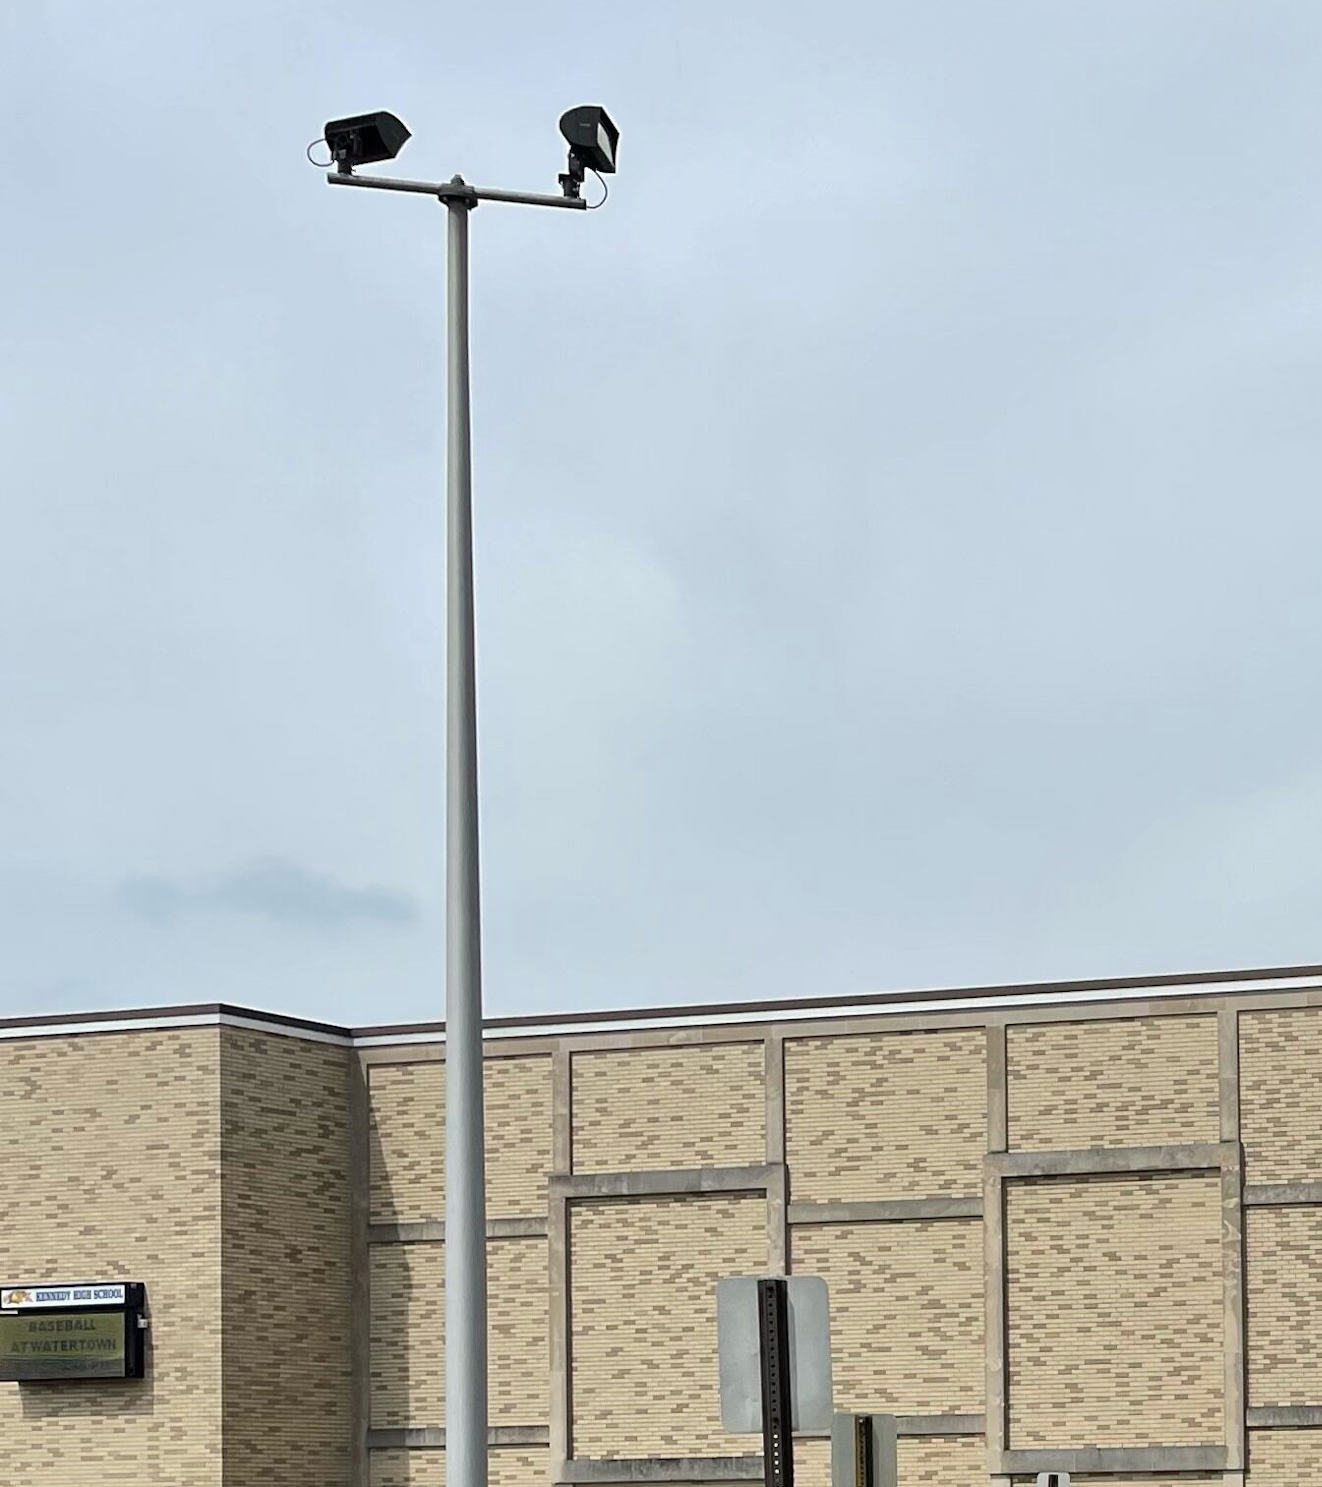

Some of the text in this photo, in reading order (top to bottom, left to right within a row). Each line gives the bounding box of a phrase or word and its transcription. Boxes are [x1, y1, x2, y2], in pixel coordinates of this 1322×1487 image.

[36, 1288, 123, 1302] KENNEDY HIGH SCHOOL
[28, 1319, 96, 1333] BASEBALL
[30, 1338, 117, 1353] WATERTOWN
